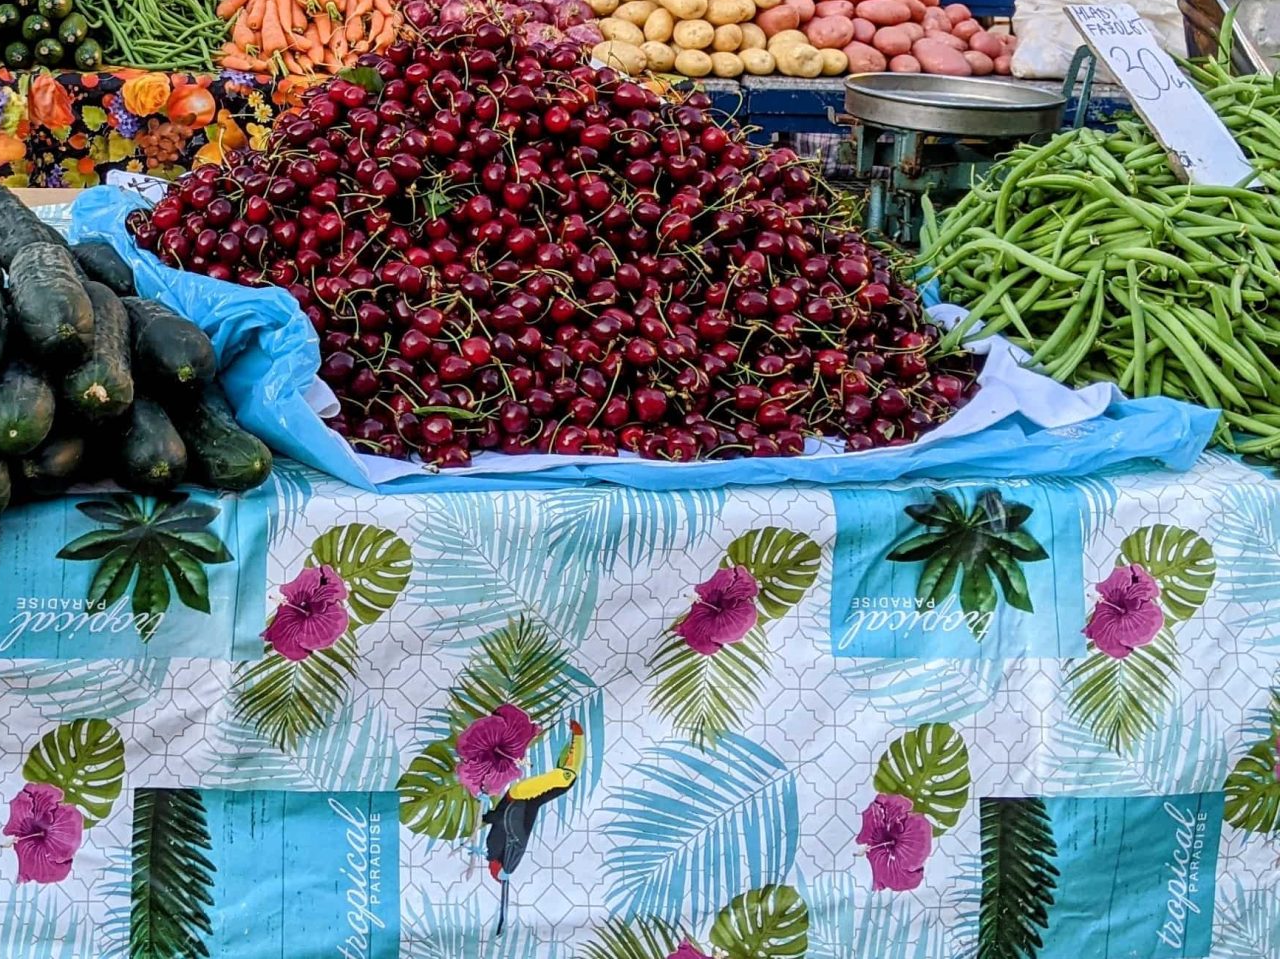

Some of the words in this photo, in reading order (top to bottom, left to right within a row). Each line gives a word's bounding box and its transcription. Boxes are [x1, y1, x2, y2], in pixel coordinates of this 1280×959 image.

[1109, 46, 1171, 101] 30
[17, 597, 107, 610] PARADISE
[838, 593, 994, 650] tropical
[852, 597, 936, 609] PARADISE
[370, 813, 381, 905] PARADISE
[1156, 801, 1201, 949] tropical
[1189, 812, 1207, 892] PARADISE
